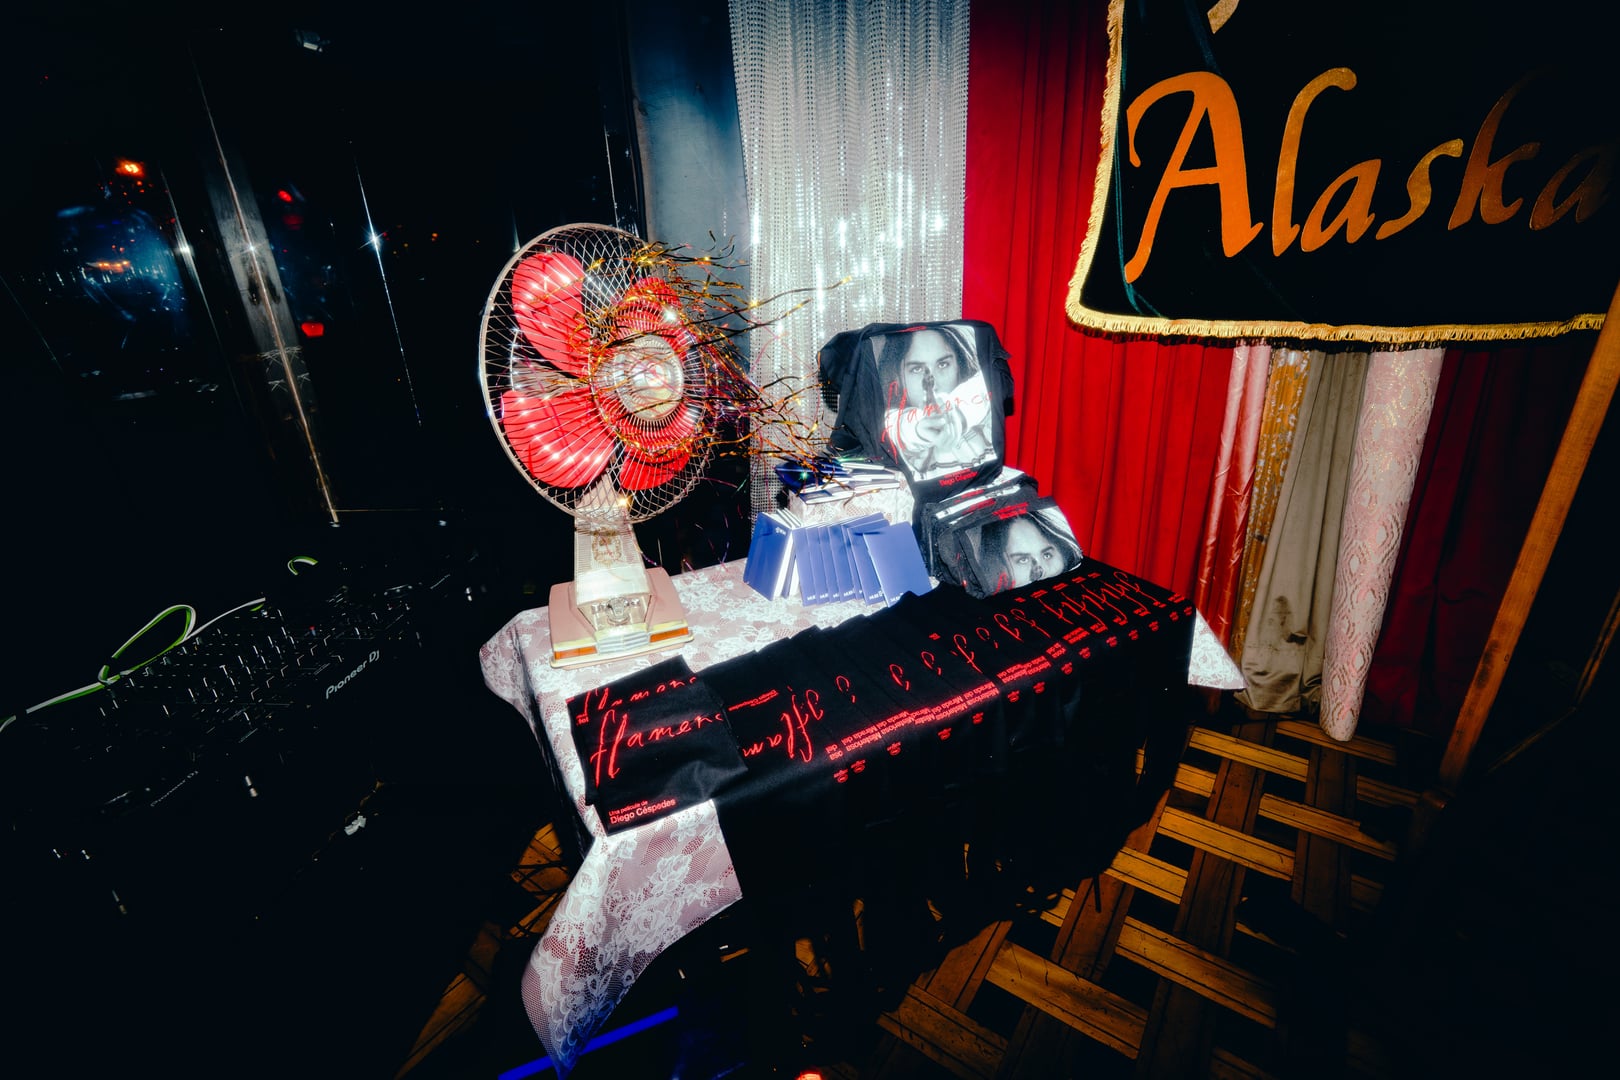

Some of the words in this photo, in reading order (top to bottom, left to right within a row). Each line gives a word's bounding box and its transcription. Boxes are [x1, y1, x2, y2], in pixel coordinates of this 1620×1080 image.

[1124, 66, 1618, 284] Alaska
[326, 660, 368, 699] Pioneer
[369, 650, 380, 663] DJ
[966, 687, 1000, 705] Misteriosa
[936, 702, 968, 720] Misteriosa
[841, 736, 854, 745] del
[846, 731, 882, 751] Misteriosa
[853, 725, 878, 739] Mirada
[589, 709, 724, 789] flamenc
[610, 811, 636, 824] Diego
[635, 799, 677, 816] Céspedes
